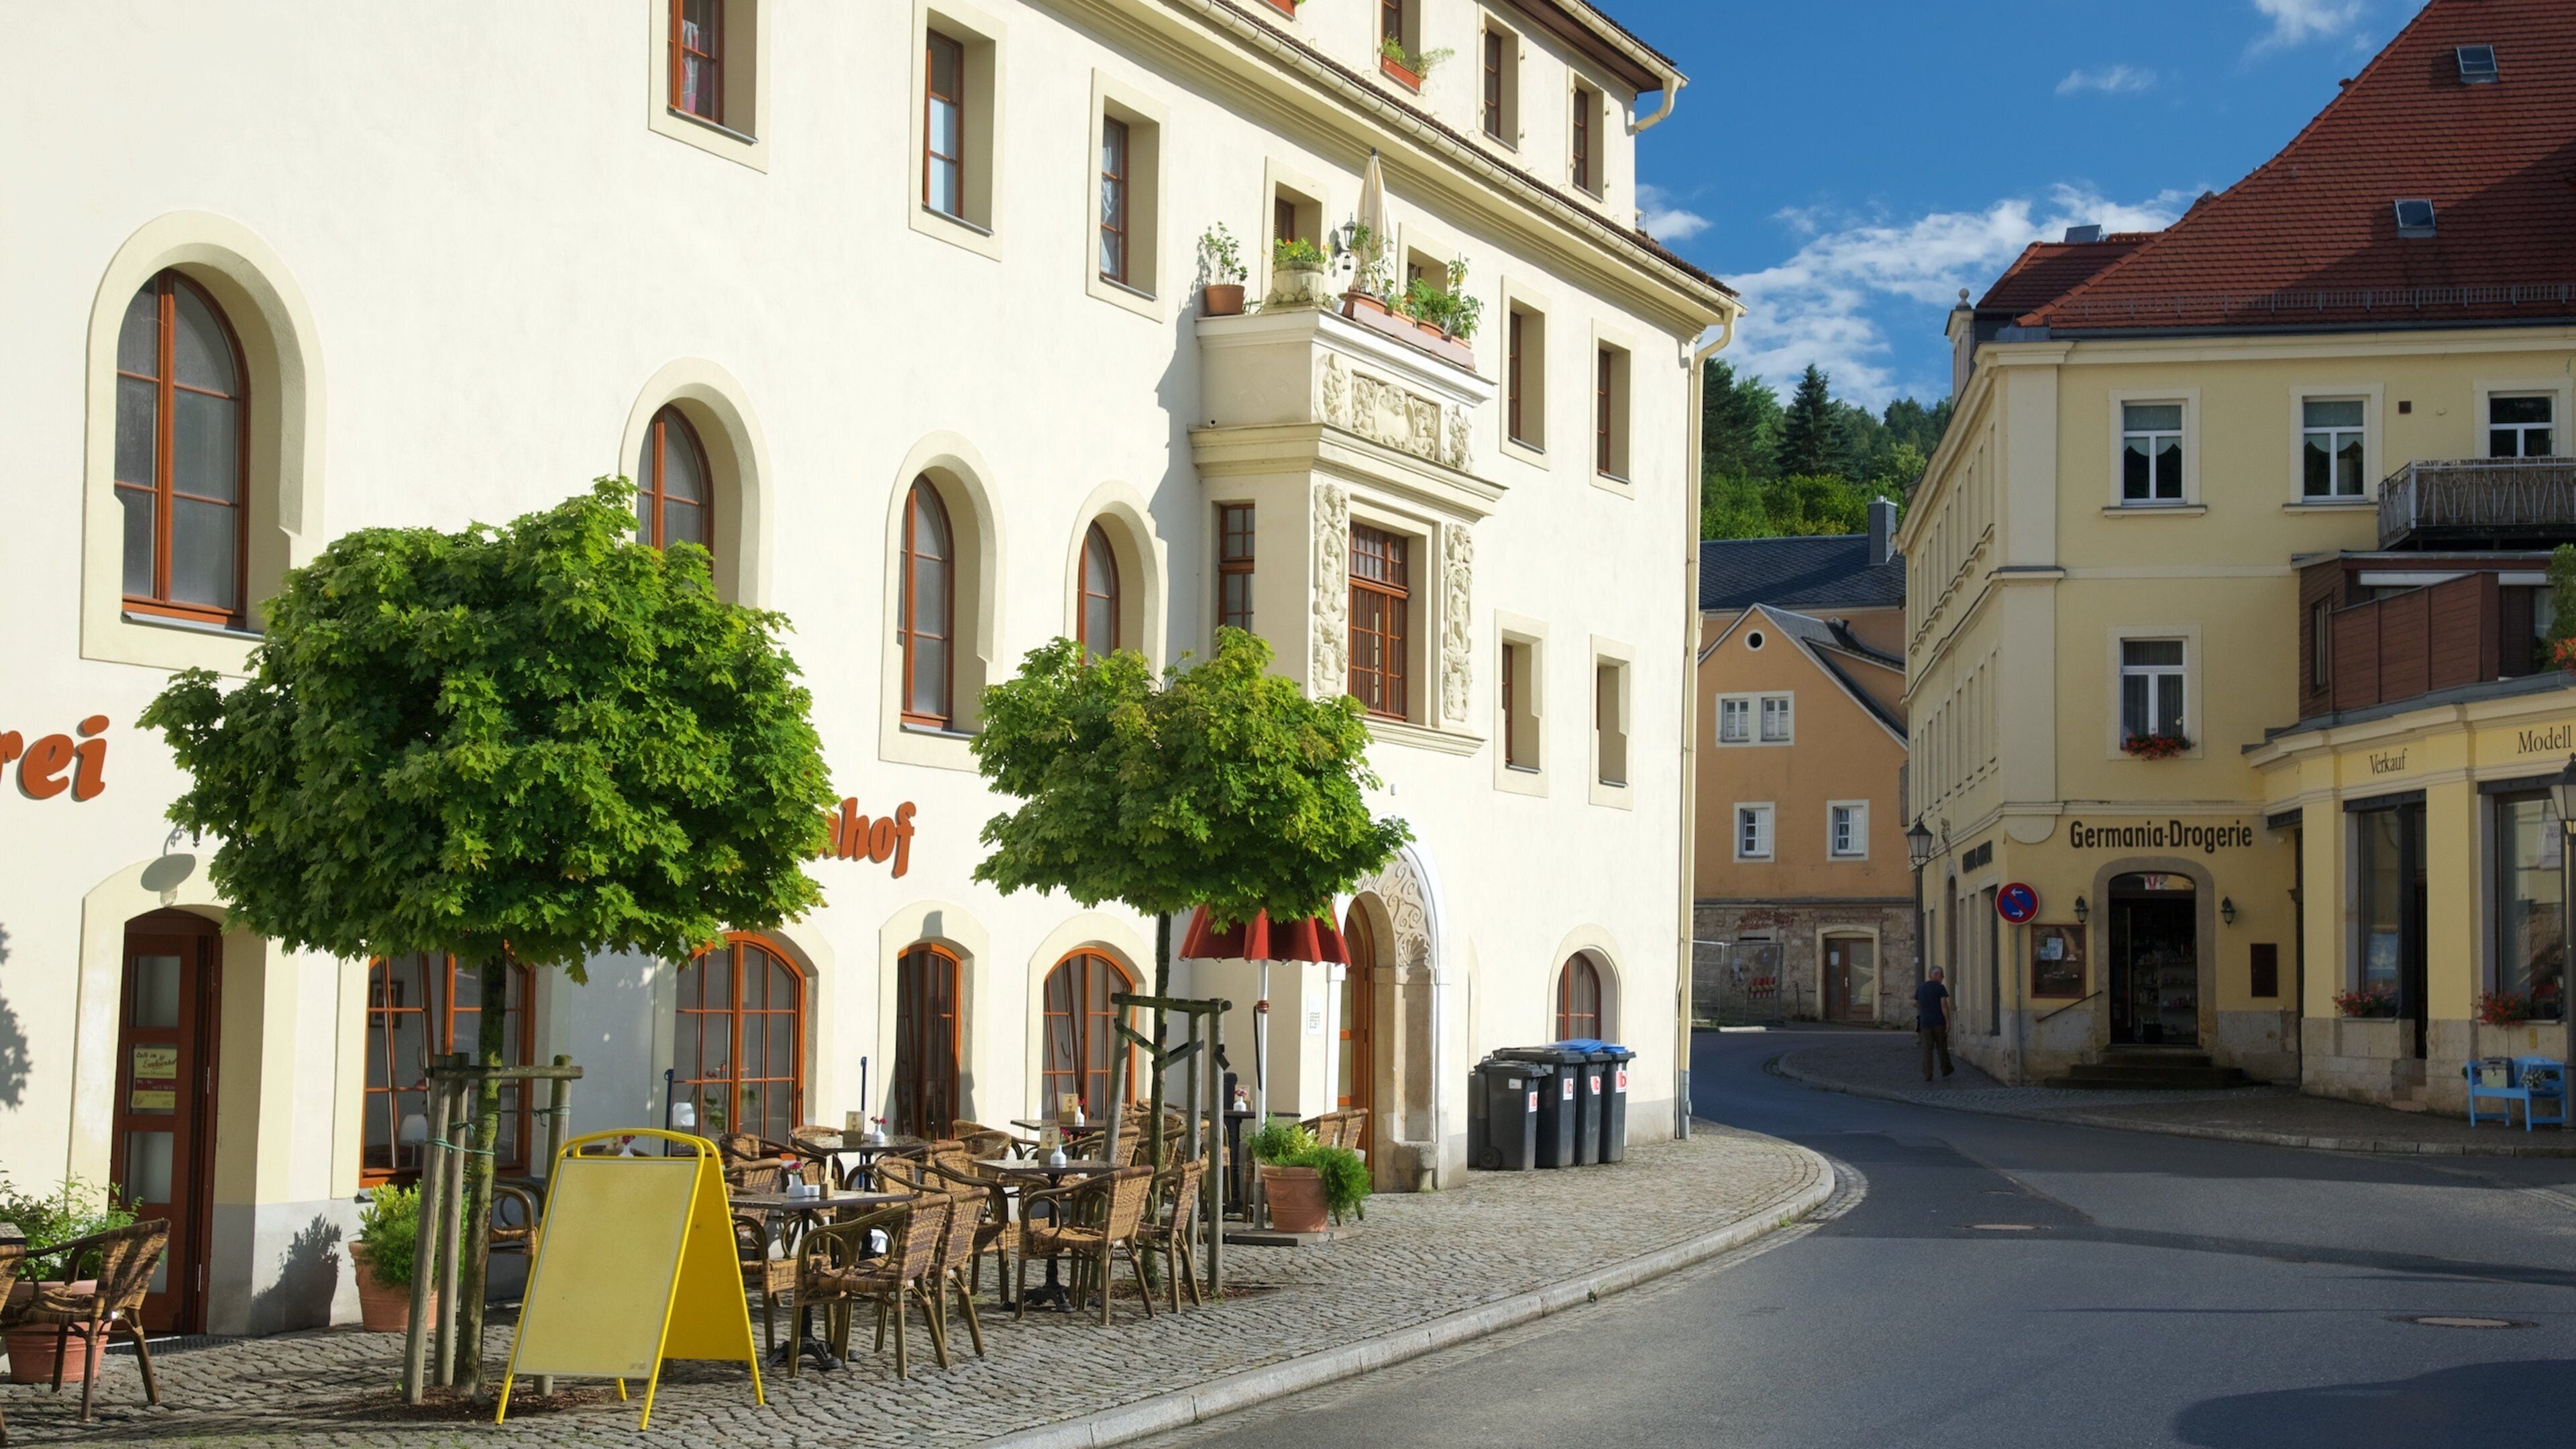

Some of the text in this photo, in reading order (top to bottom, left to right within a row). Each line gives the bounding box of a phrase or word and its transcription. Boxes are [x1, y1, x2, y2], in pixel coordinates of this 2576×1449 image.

[2518, 725, 2572, 754] Modell
[2369, 749, 2407, 775] Verkauf
[2070, 820, 2253, 854] Germania-Drogerie
